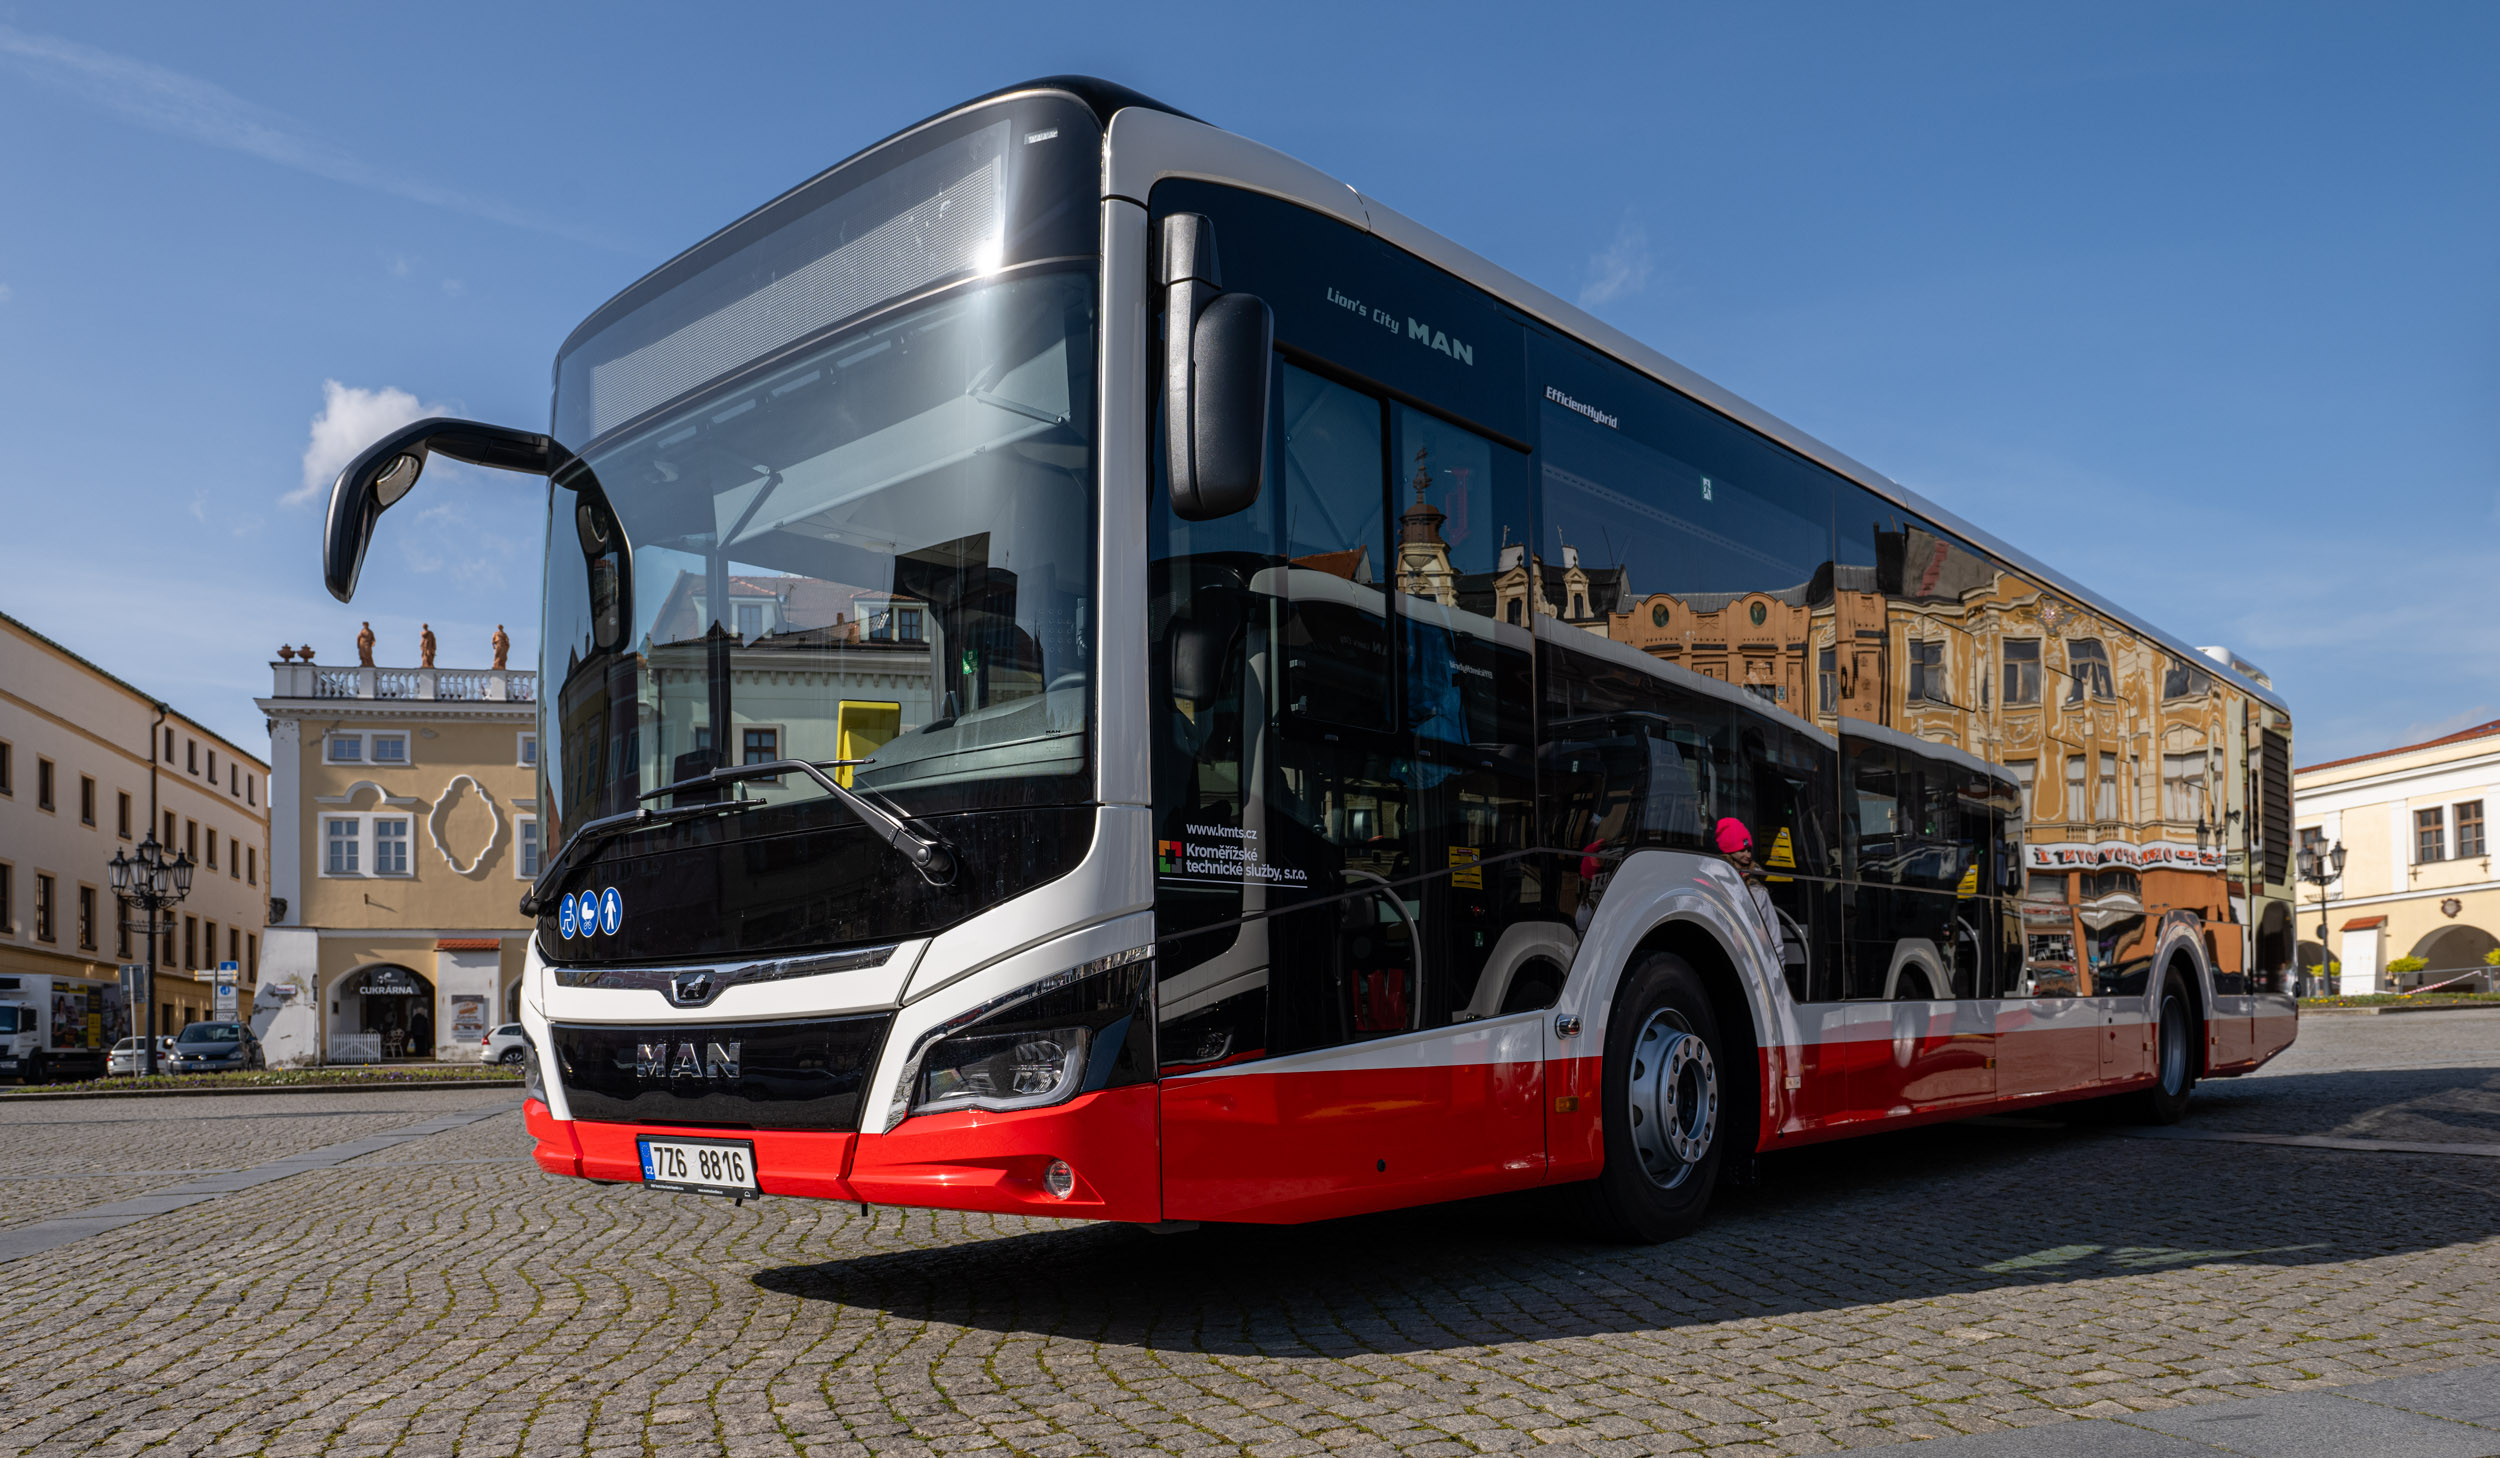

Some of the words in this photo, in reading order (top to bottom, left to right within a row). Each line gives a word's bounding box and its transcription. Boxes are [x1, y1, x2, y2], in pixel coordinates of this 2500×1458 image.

[1327, 287, 1367, 316] Lion's
[1373, 308, 1399, 334] City
[1408, 317, 1473, 366] MAN
[1546, 385, 1618, 429] EfficientHybrid
[1186, 823, 1257, 840] www.kmts.cz
[1186, 843, 1258, 861] Kroměřížské
[1186, 860, 1243, 876] technické
[1245, 864, 1283, 881] služby,
[1284, 868, 1308, 880] s.r.o.
[360, 985, 413, 994] CUKRÁRNA
[637, 1042, 740, 1078] MAN
[645, 1166, 654, 1175] CZ
[654, 1146, 688, 1178] 7Z6
[698, 1149, 745, 1182] 8816
